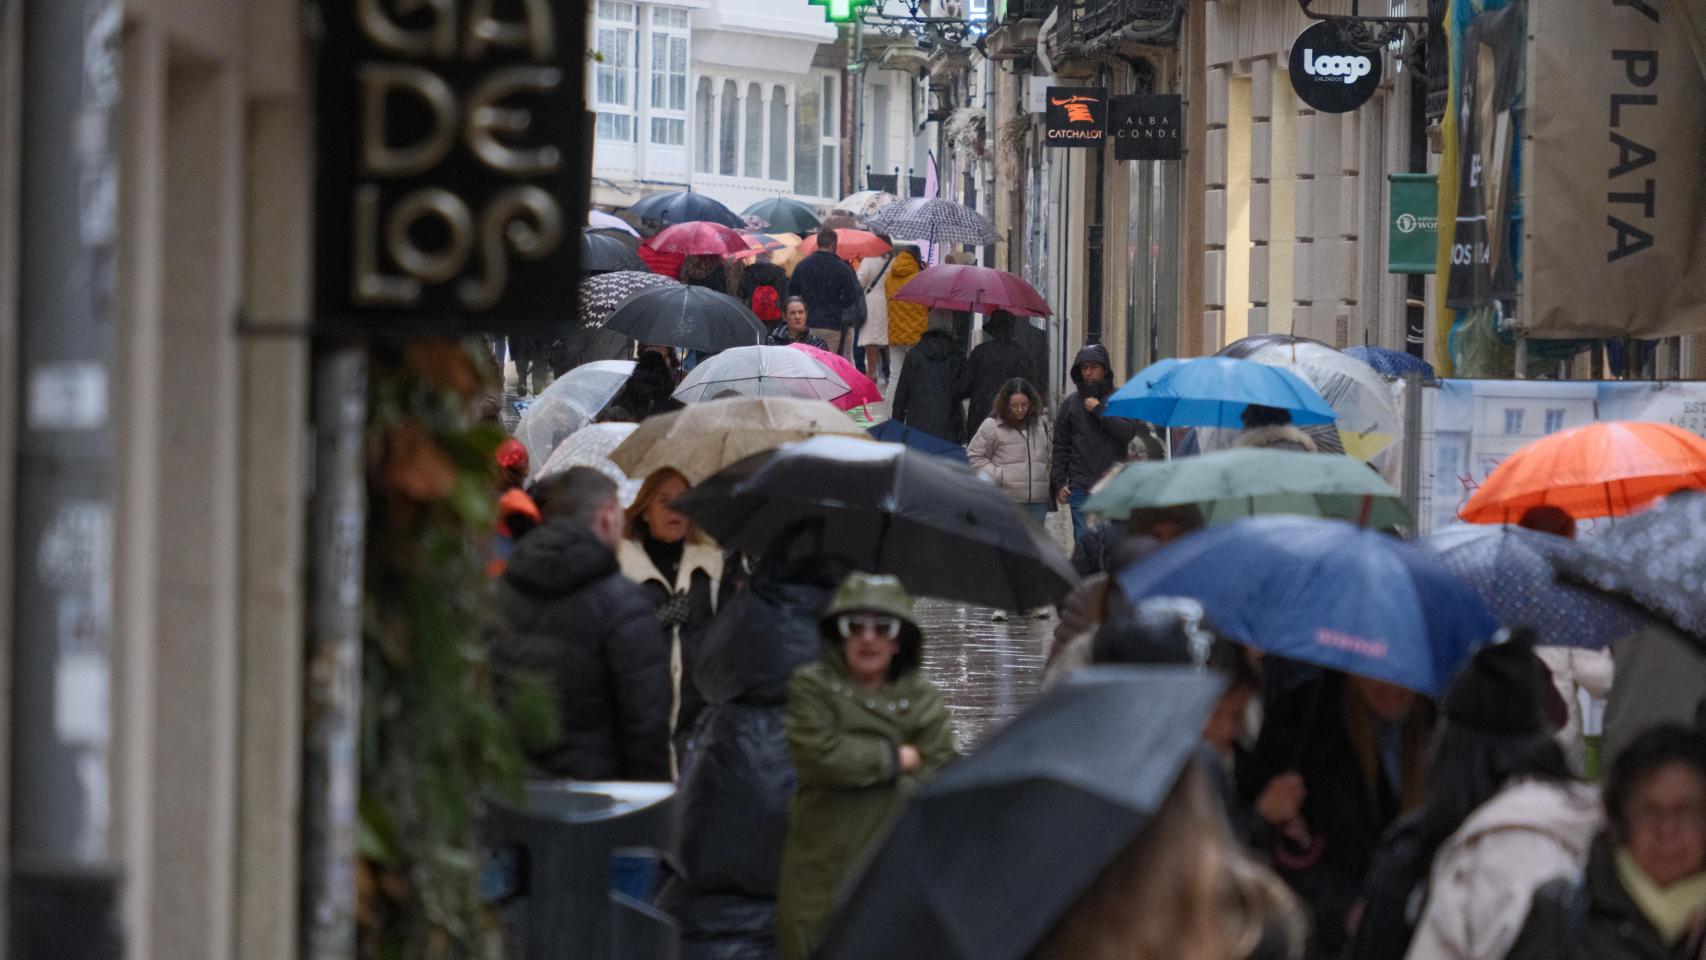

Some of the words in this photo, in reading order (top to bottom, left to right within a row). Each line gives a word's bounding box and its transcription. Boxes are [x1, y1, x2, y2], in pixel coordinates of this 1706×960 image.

[360, 62, 562, 175] DE
[1048, 129, 1103, 140] CATCHALOT
[1117, 129, 1178, 138] CONDE
[1126, 116, 1169, 126] ALBA
[1607, 50, 1659, 263] PLATA
[355, 183, 563, 310] LOS
